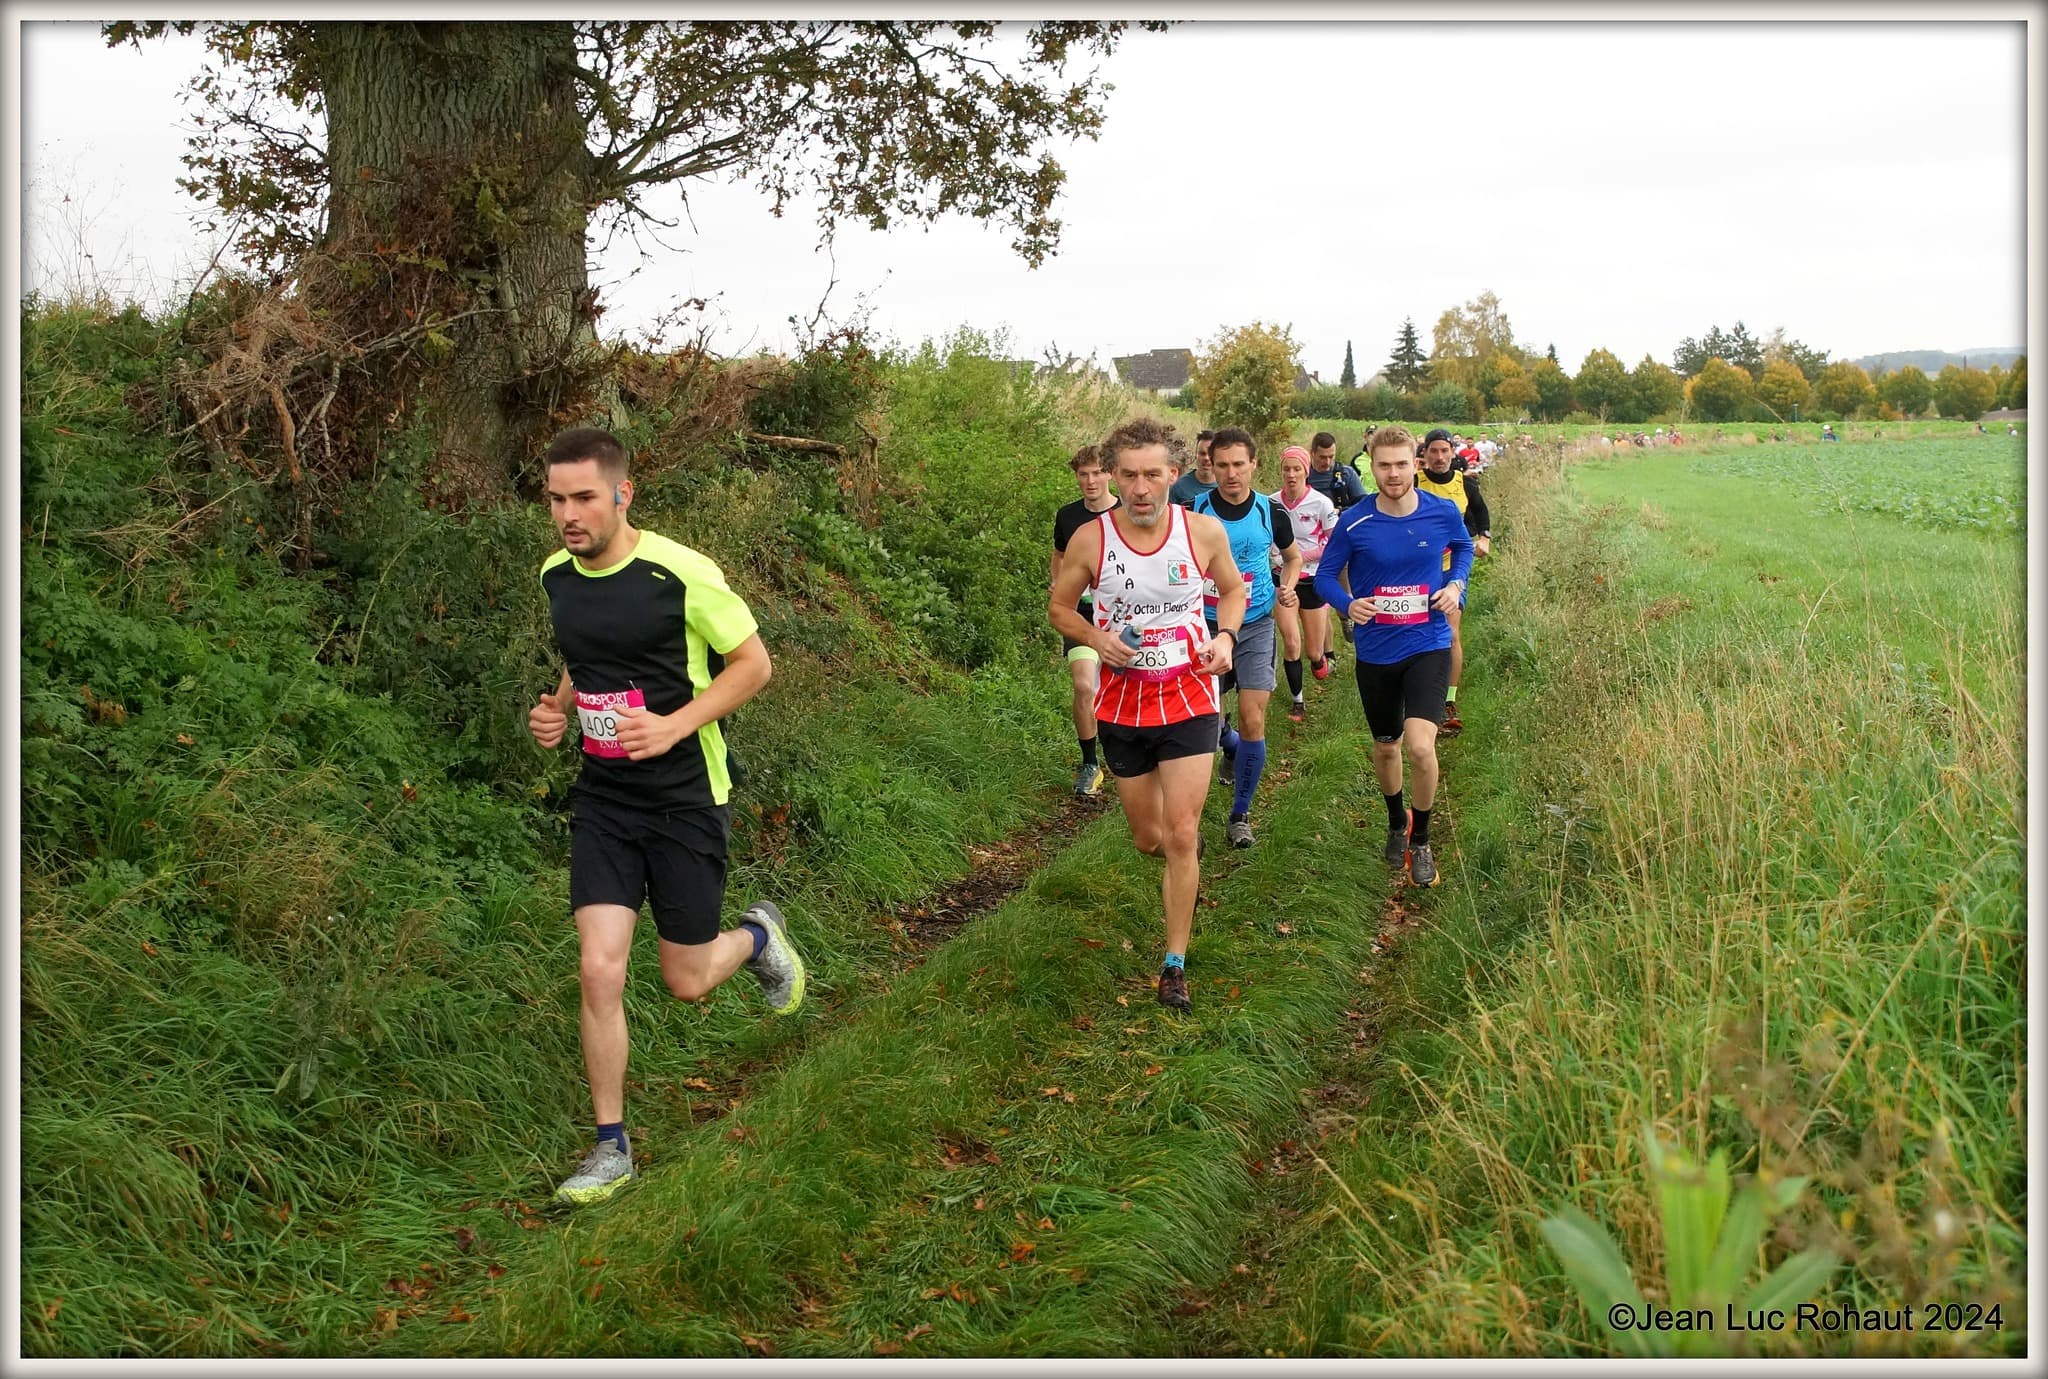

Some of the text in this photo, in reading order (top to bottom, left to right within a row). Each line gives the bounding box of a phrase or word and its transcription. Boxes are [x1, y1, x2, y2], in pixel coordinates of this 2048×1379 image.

[1381, 585, 1420, 594] PROSPORT
[1134, 603, 1161, 615] Octau
[1382, 599, 1410, 613] 236
[1134, 650, 1168, 667] 263
[578, 692, 628, 705] PROSPORT
[587, 716, 617, 737] 409
